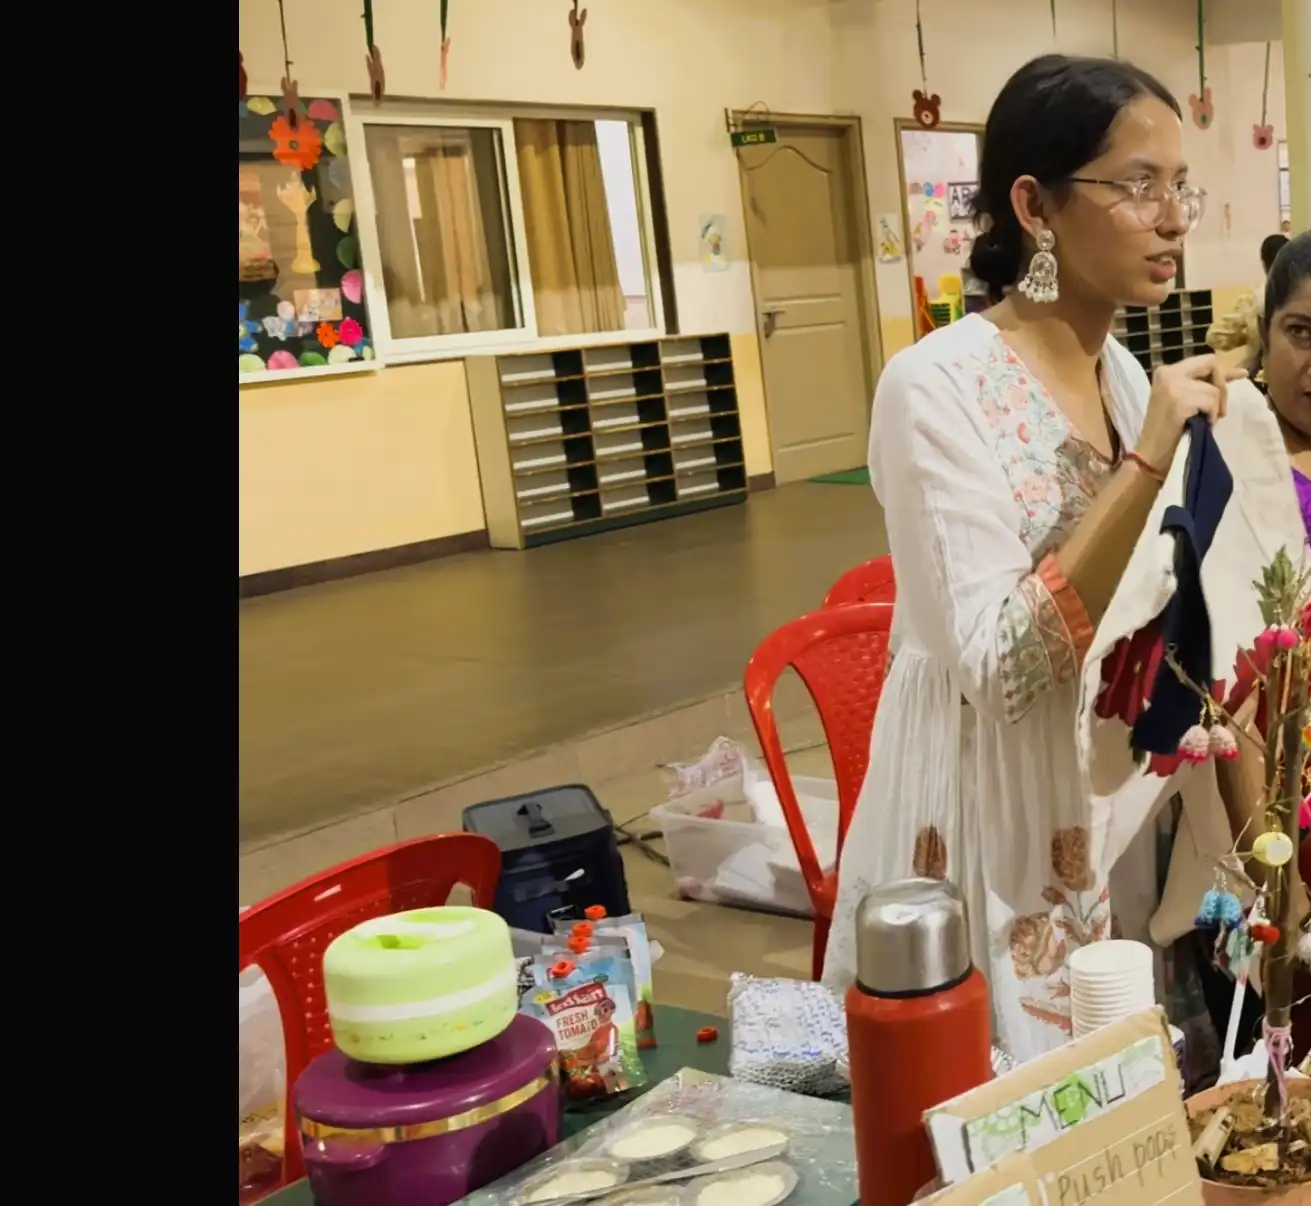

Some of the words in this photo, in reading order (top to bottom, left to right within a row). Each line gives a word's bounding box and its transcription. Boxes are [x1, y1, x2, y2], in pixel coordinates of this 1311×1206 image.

[555, 1009, 589, 1030] FRESH
[558, 1018, 598, 1041] TOMATO
[1019, 1063, 1126, 1150] MENU
[1058, 1149, 1124, 1206] Push
